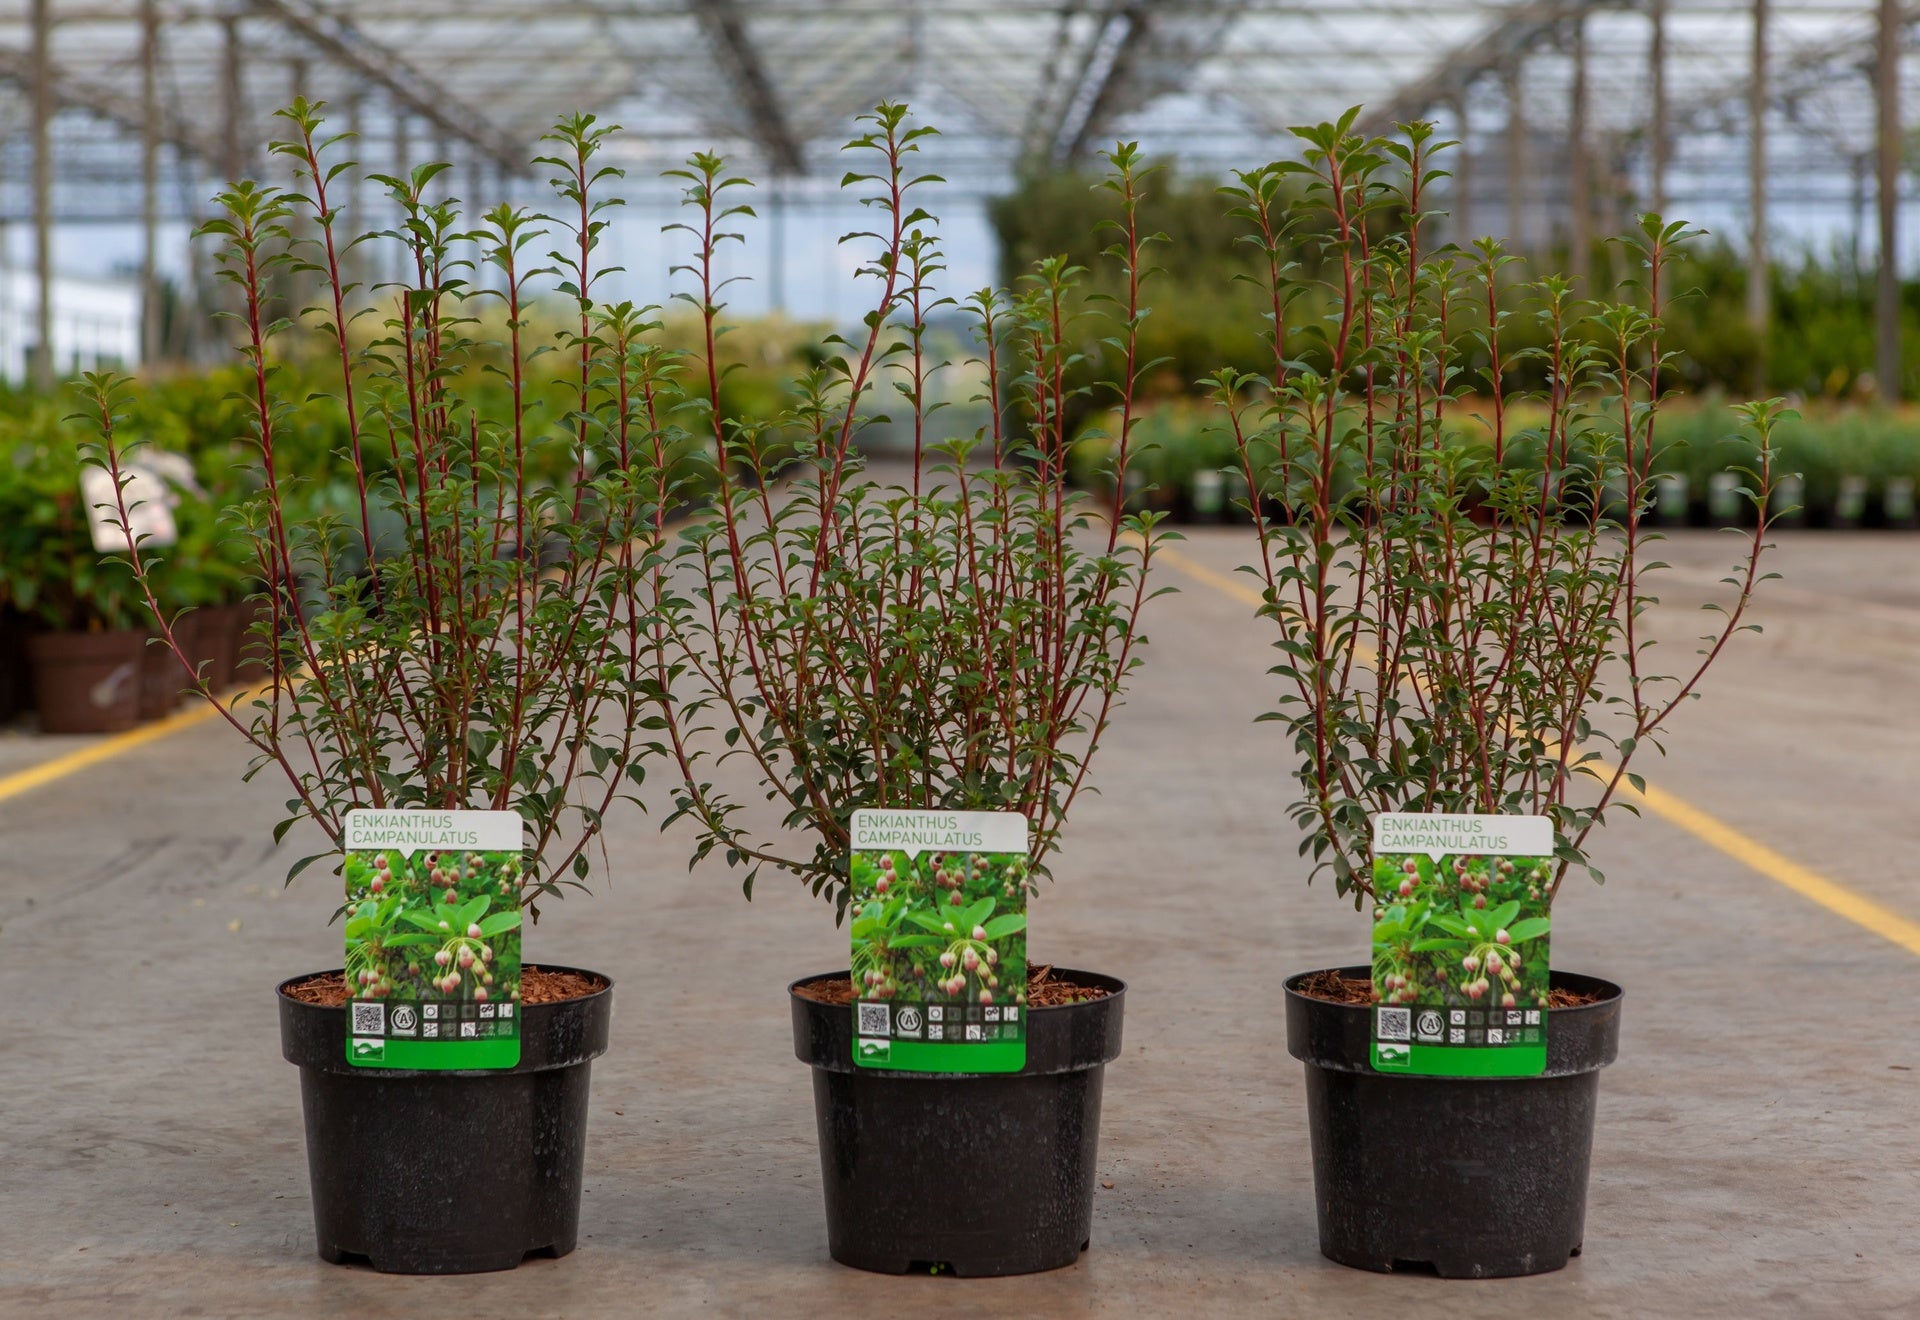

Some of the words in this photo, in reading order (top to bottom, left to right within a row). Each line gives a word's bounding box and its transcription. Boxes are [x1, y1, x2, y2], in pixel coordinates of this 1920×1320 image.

[352, 815, 452, 828] ENKIANTHUS
[858, 815, 958, 830] ENKIANTHUS
[1382, 818, 1482, 832] ENKIANTHUS
[352, 830, 478, 844] CAMPANULATUS
[858, 830, 982, 846] CAMPANULATUS
[1382, 834, 1508, 850] CAMPANULATUS
